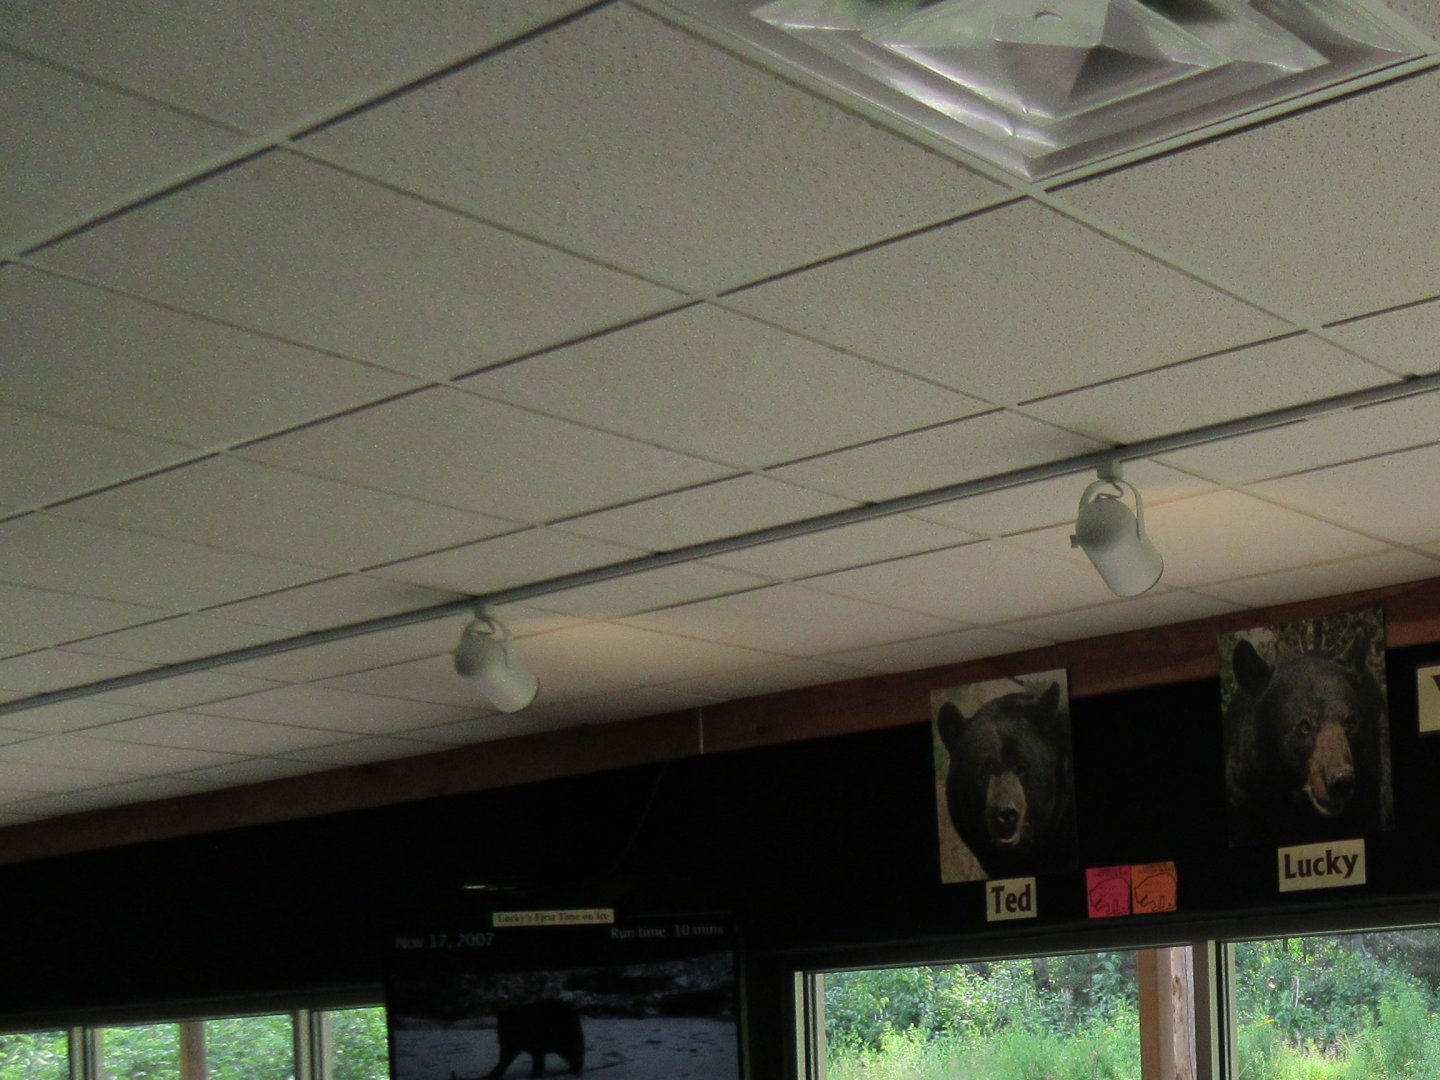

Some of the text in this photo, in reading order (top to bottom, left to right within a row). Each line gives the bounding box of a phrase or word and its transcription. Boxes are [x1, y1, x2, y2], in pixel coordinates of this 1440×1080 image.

[1284, 849, 1358, 879] Lucky
[991, 884, 1032, 913] Ted
[535, 912, 556, 923] First
[559, 912, 581, 922] Time
[582, 913, 594, 921] on
[596, 911, 609, 921] Ice
[394, 931, 496, 949] Nov 17, 2007
[610, 927, 635, 939] Run
[674, 923, 690, 937] 10
[693, 923, 725, 936] mins
